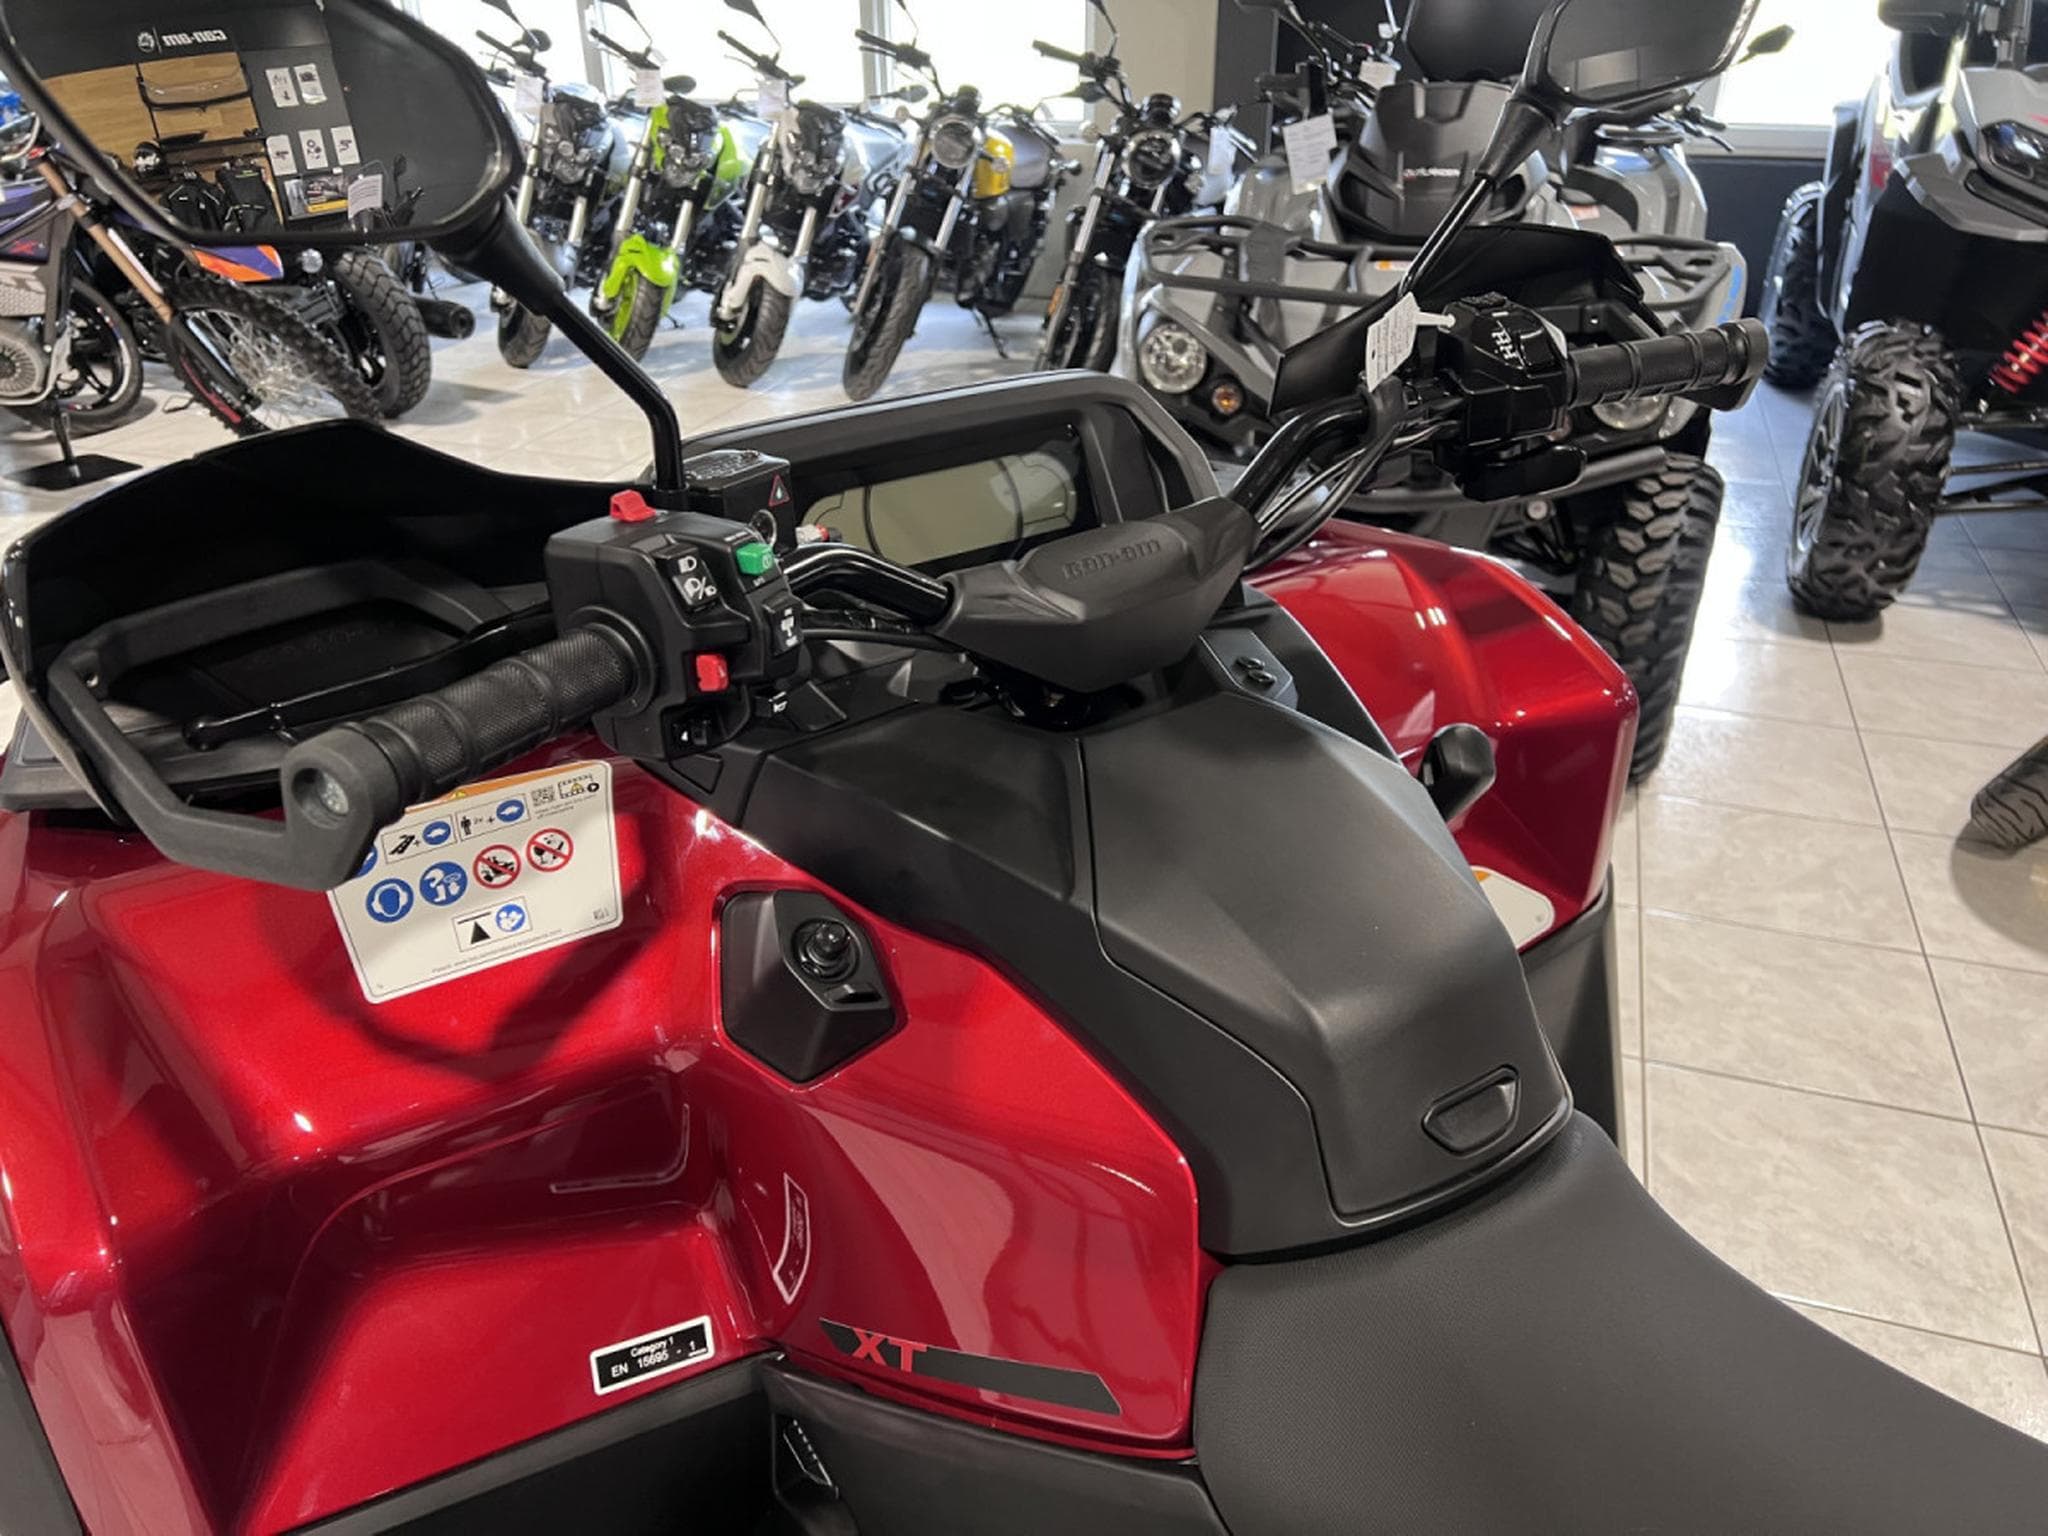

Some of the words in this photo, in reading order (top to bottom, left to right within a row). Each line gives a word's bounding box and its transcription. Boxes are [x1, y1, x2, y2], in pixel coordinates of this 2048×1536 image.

[630, 1340, 667, 1357] Category
[669, 1336, 674, 1346] 1
[852, 1327, 928, 1373] XT
[611, 1362, 629, 1378] EN
